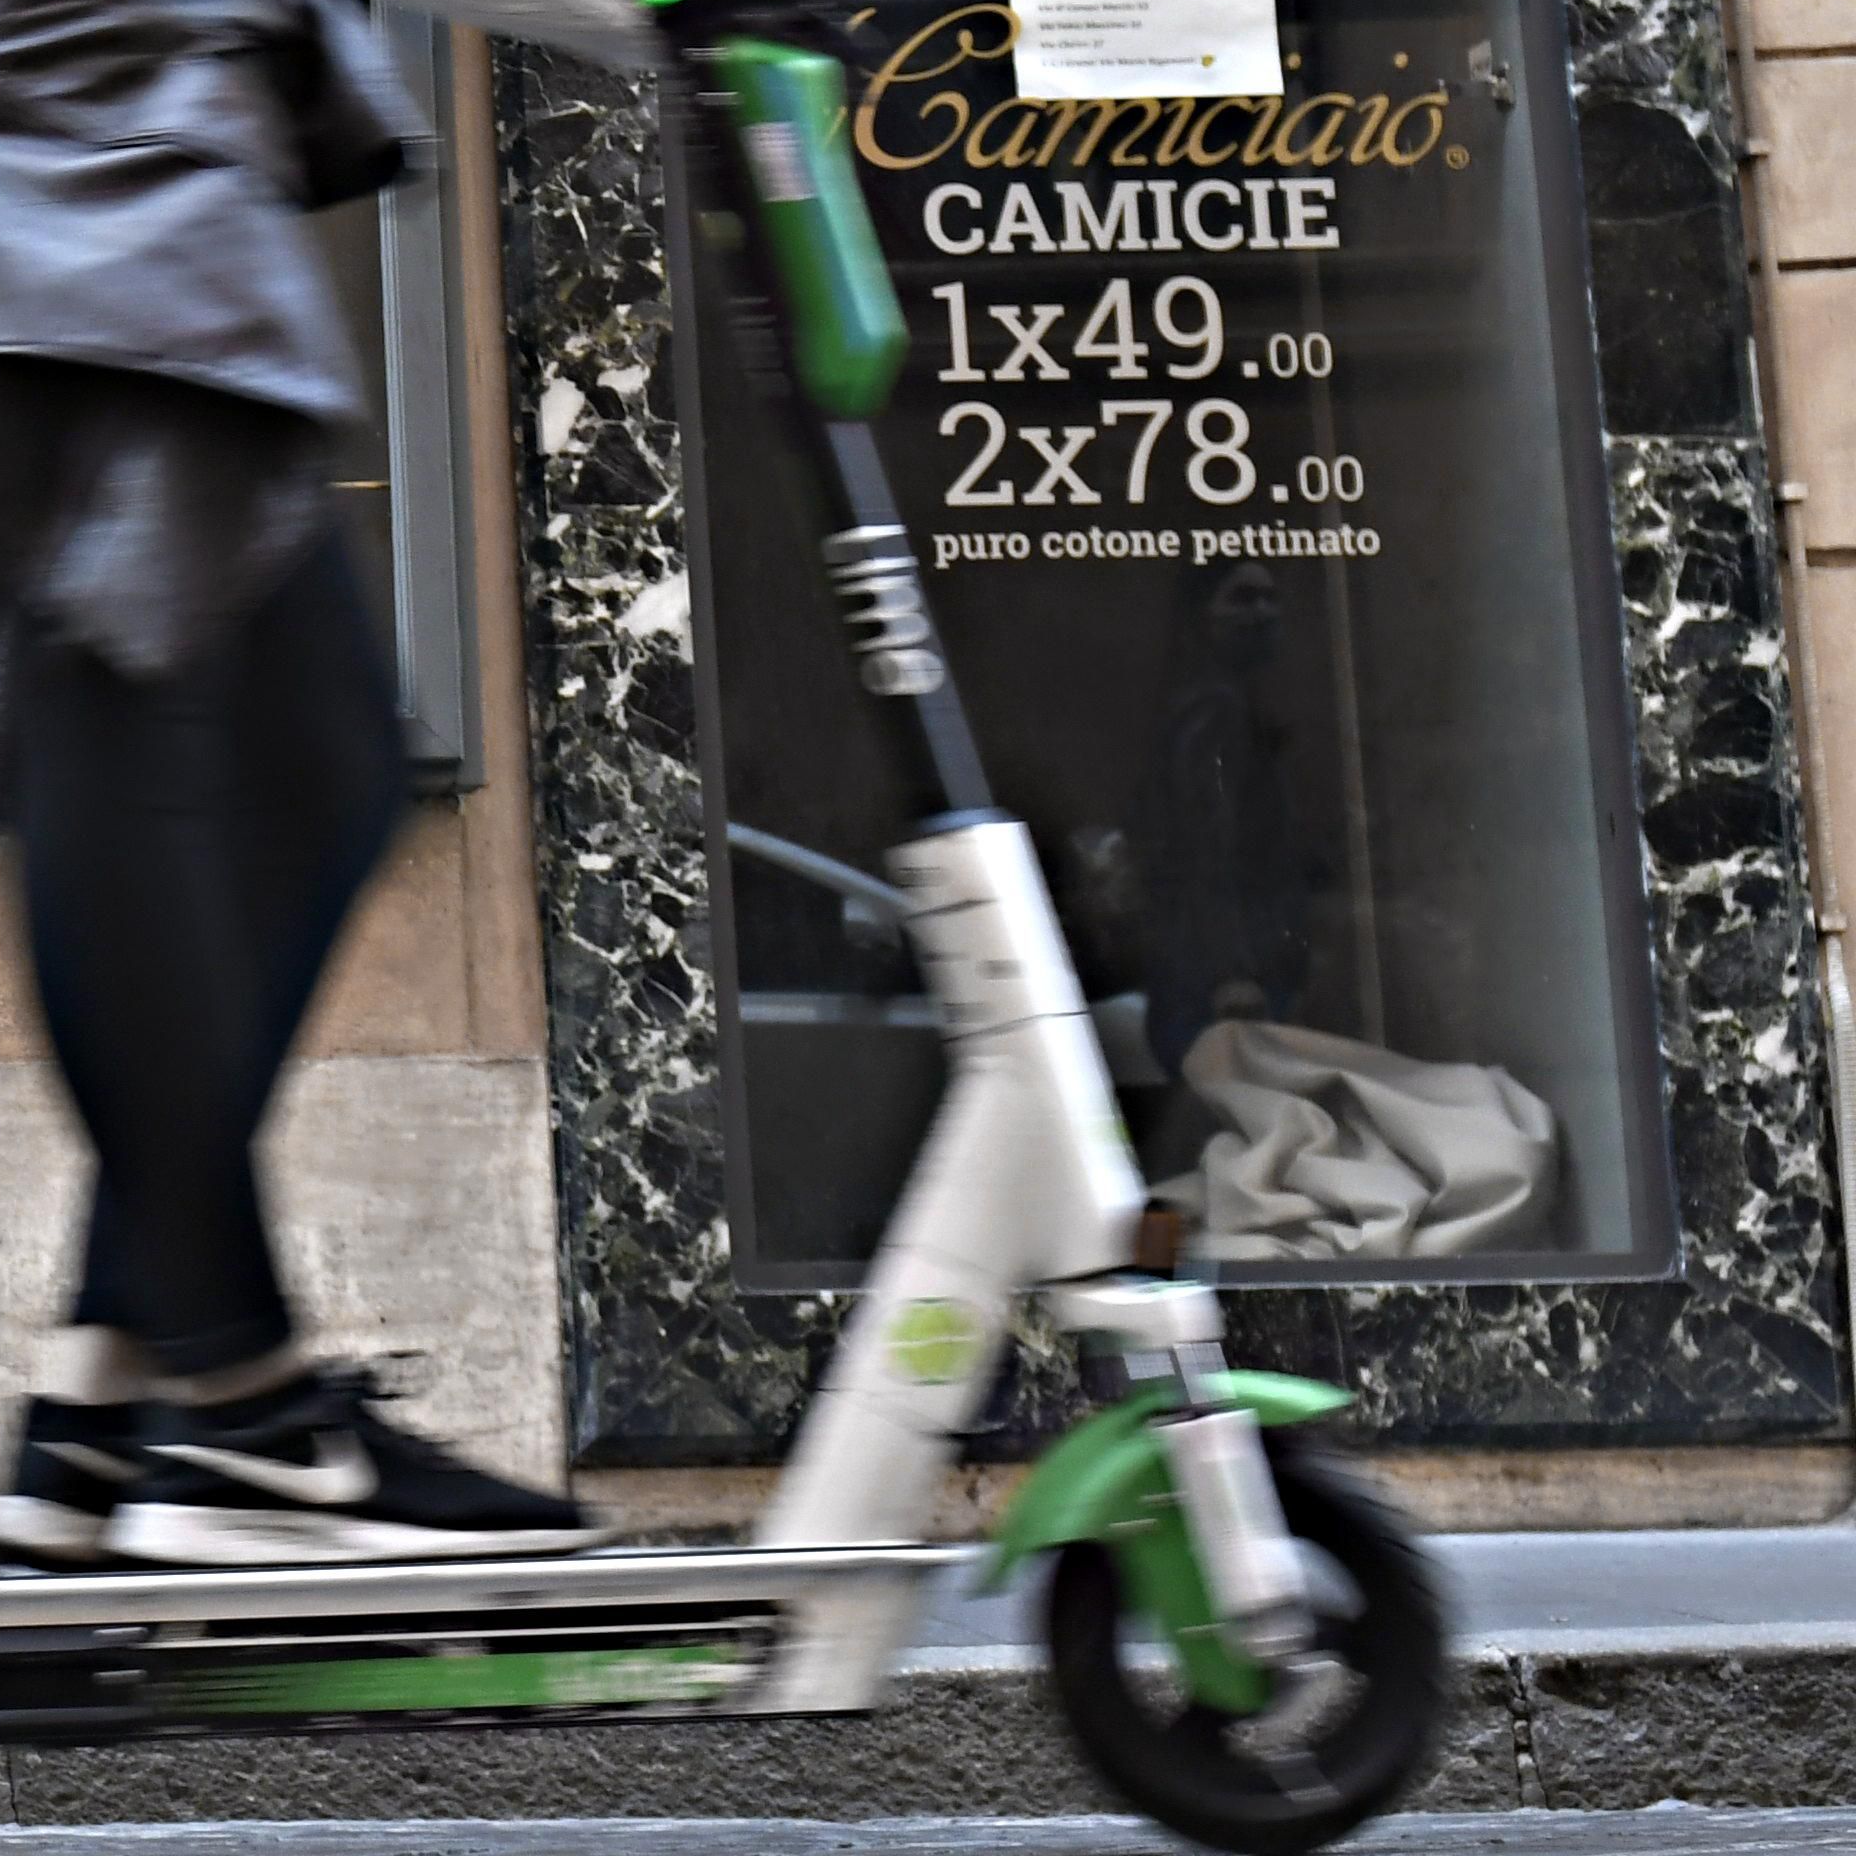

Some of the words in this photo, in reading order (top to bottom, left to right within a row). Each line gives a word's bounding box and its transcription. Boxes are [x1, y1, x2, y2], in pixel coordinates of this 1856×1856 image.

[922, 177, 1341, 254] CAMICIE
[931, 275, 1334, 383] 1x49.00
[938, 397, 1365, 506] 2x78.00
[931, 530, 1031, 569] puro
[1041, 524, 1181, 559] cotone
[1191, 519, 1382, 565] pettinato
